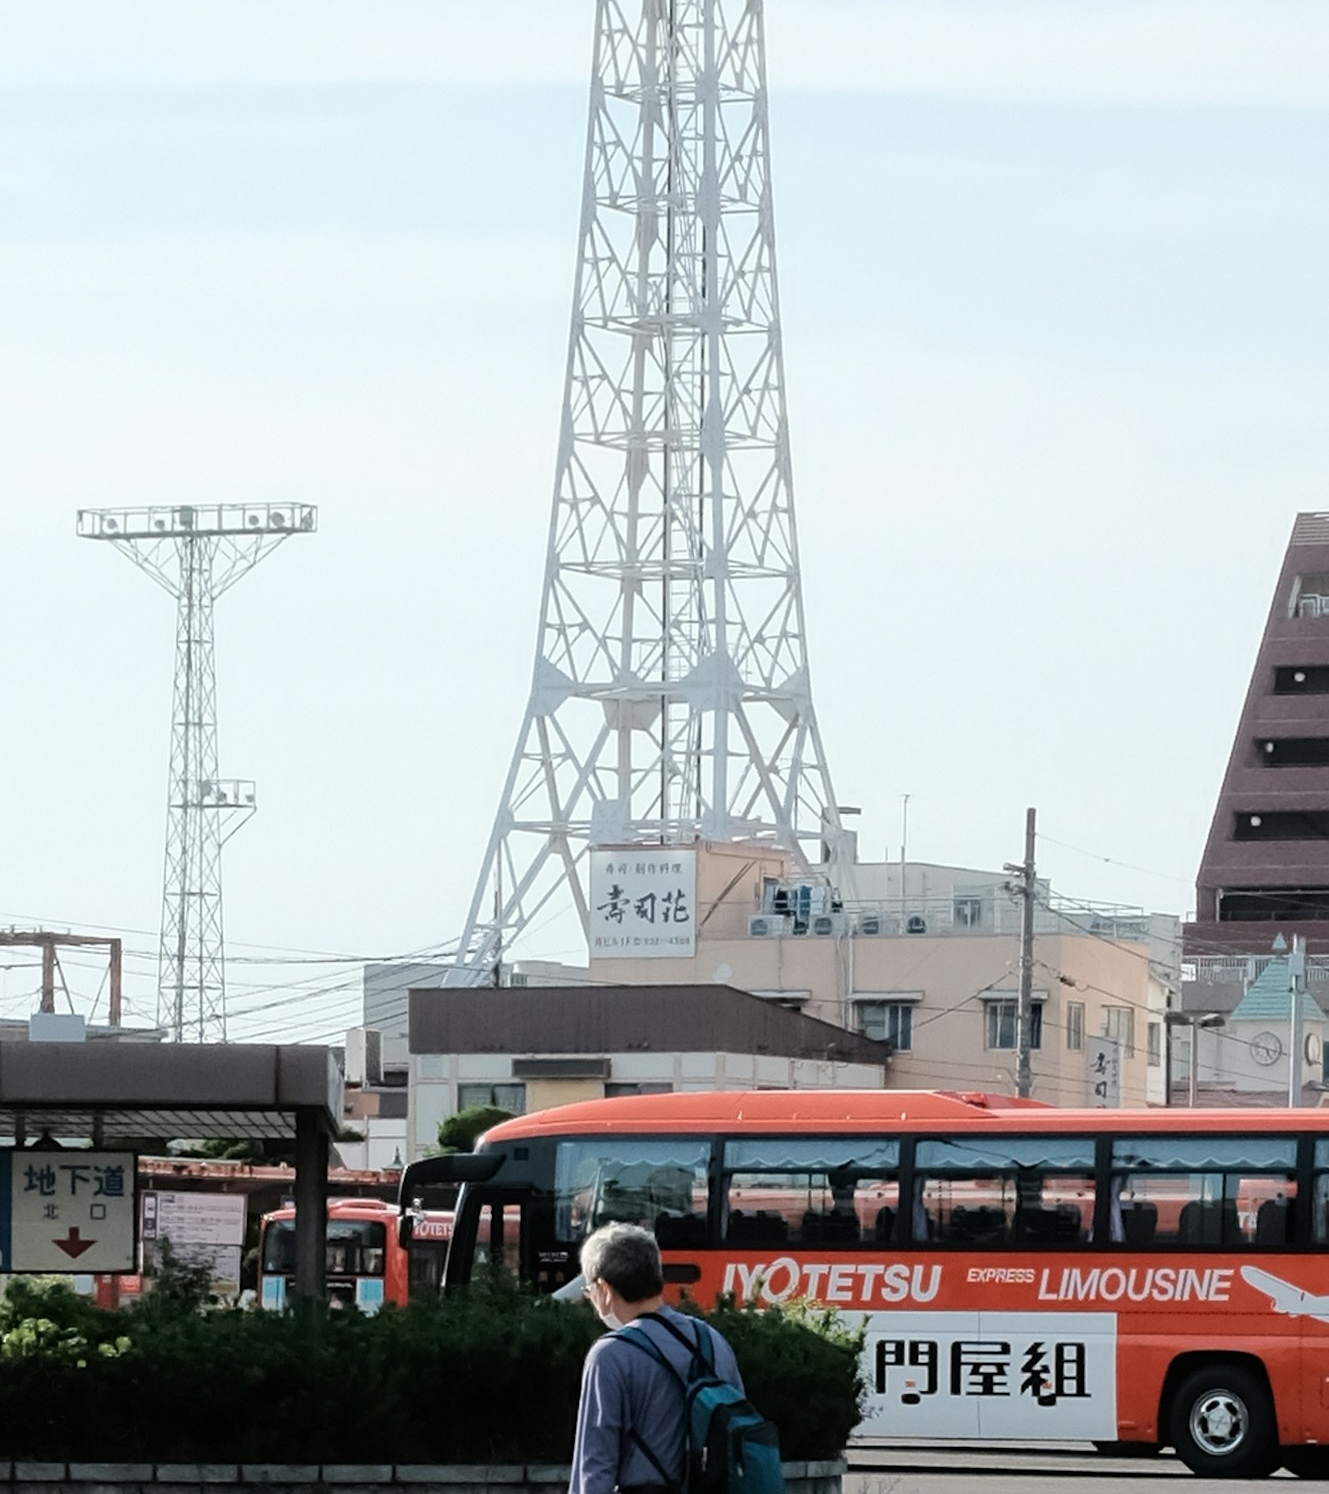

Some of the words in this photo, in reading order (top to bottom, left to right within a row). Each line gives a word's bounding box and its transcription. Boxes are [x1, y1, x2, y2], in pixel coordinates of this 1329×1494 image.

[24, 1164, 125, 1197] 地下道
[722, 1257, 942, 1305] IYOTETSU
[966, 1268, 1036, 1283] EXPRESS
[1037, 1267, 1235, 1302] LIMOUSINE
